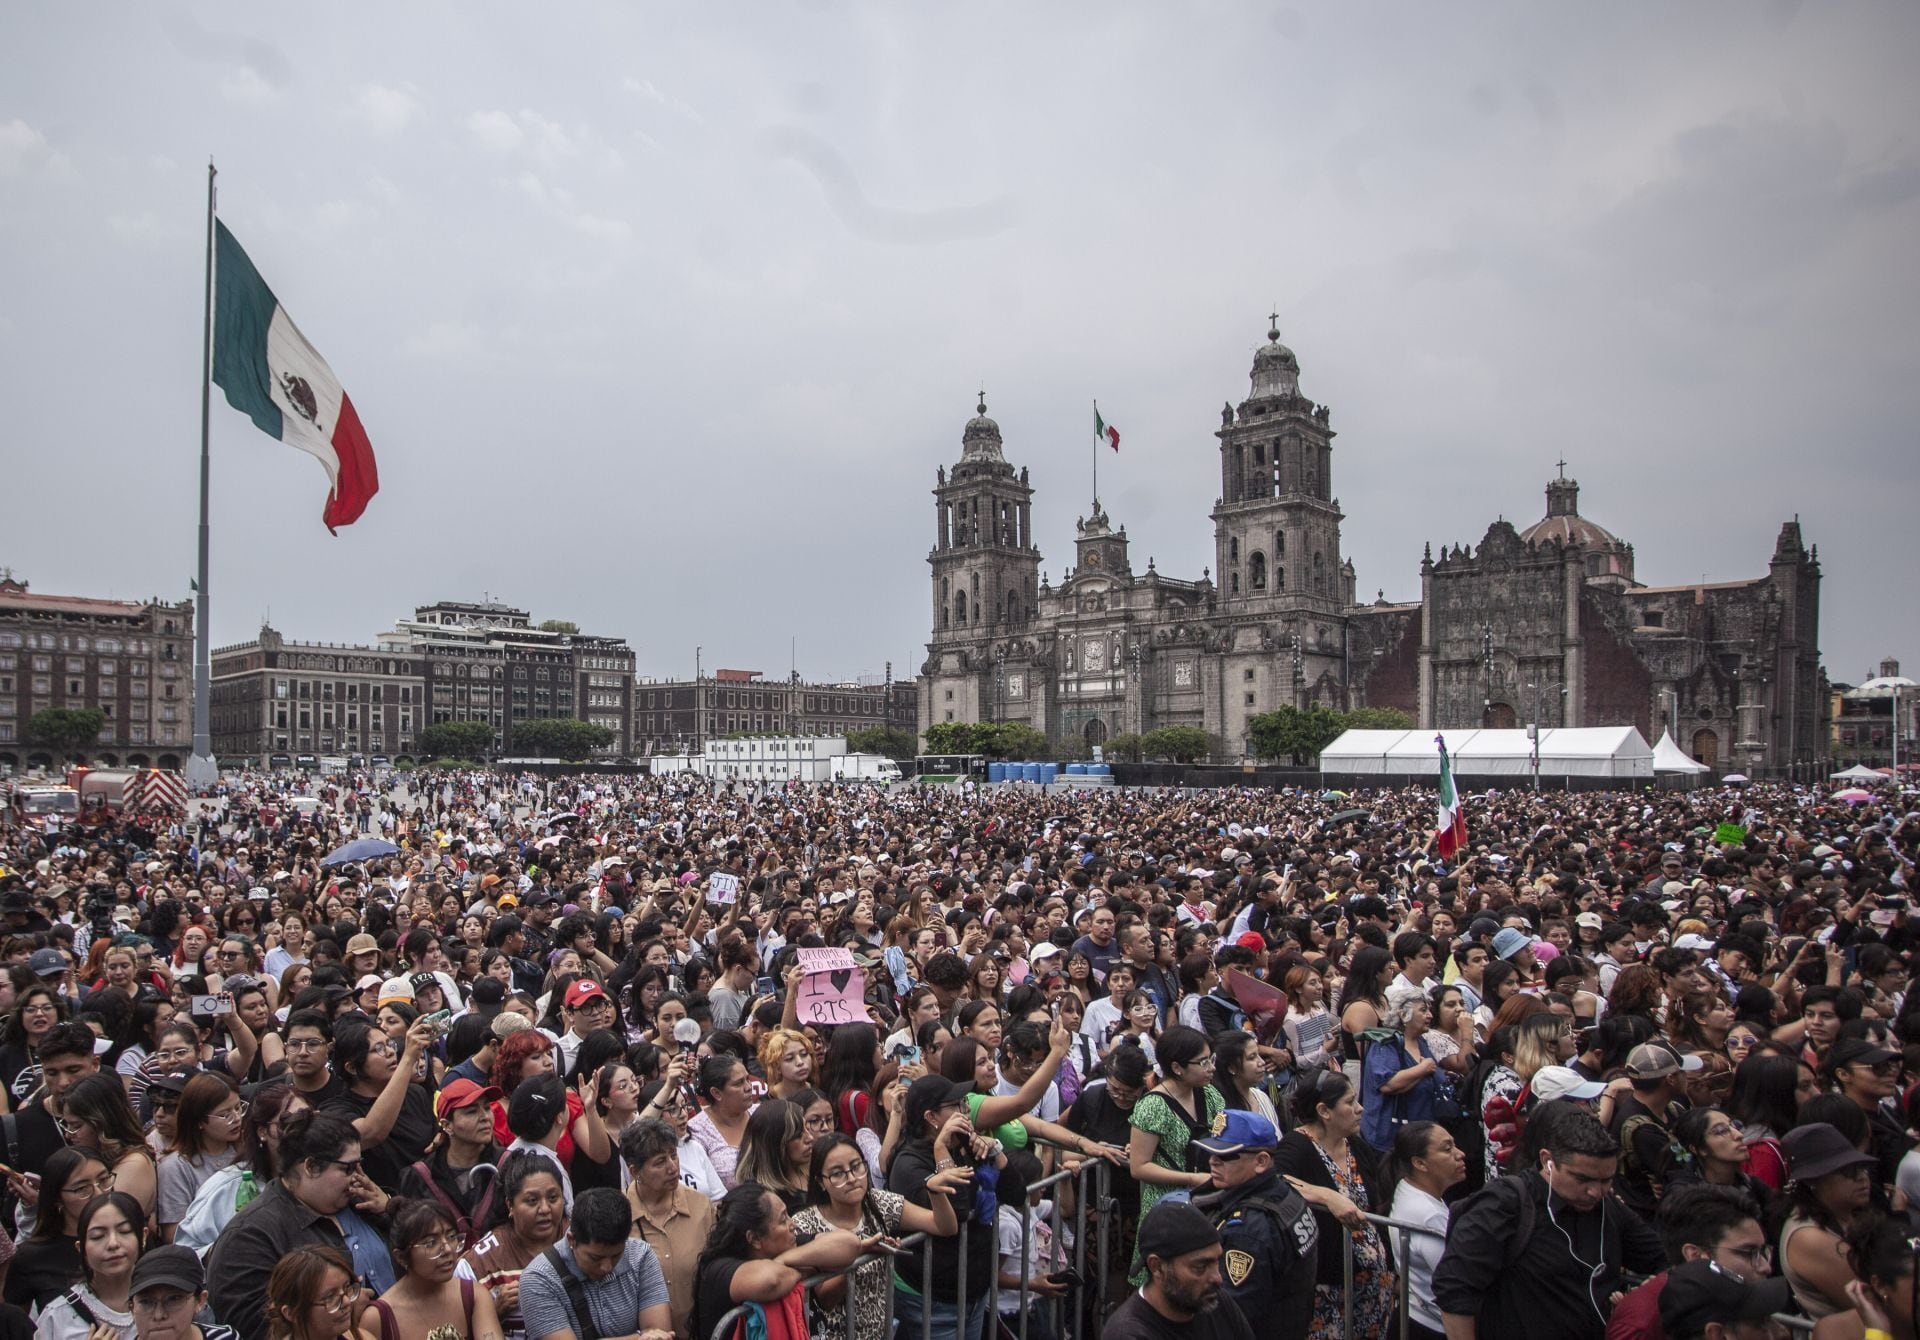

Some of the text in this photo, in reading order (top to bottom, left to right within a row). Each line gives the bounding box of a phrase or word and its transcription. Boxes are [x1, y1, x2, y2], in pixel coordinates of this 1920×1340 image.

[712, 876, 737, 891] JIN
[798, 949, 840, 960] WELCOME
[811, 961, 824, 970] TO
[805, 971, 824, 998] I
[809, 998, 853, 1023] BTS
[474, 1233, 499, 1255] 5
